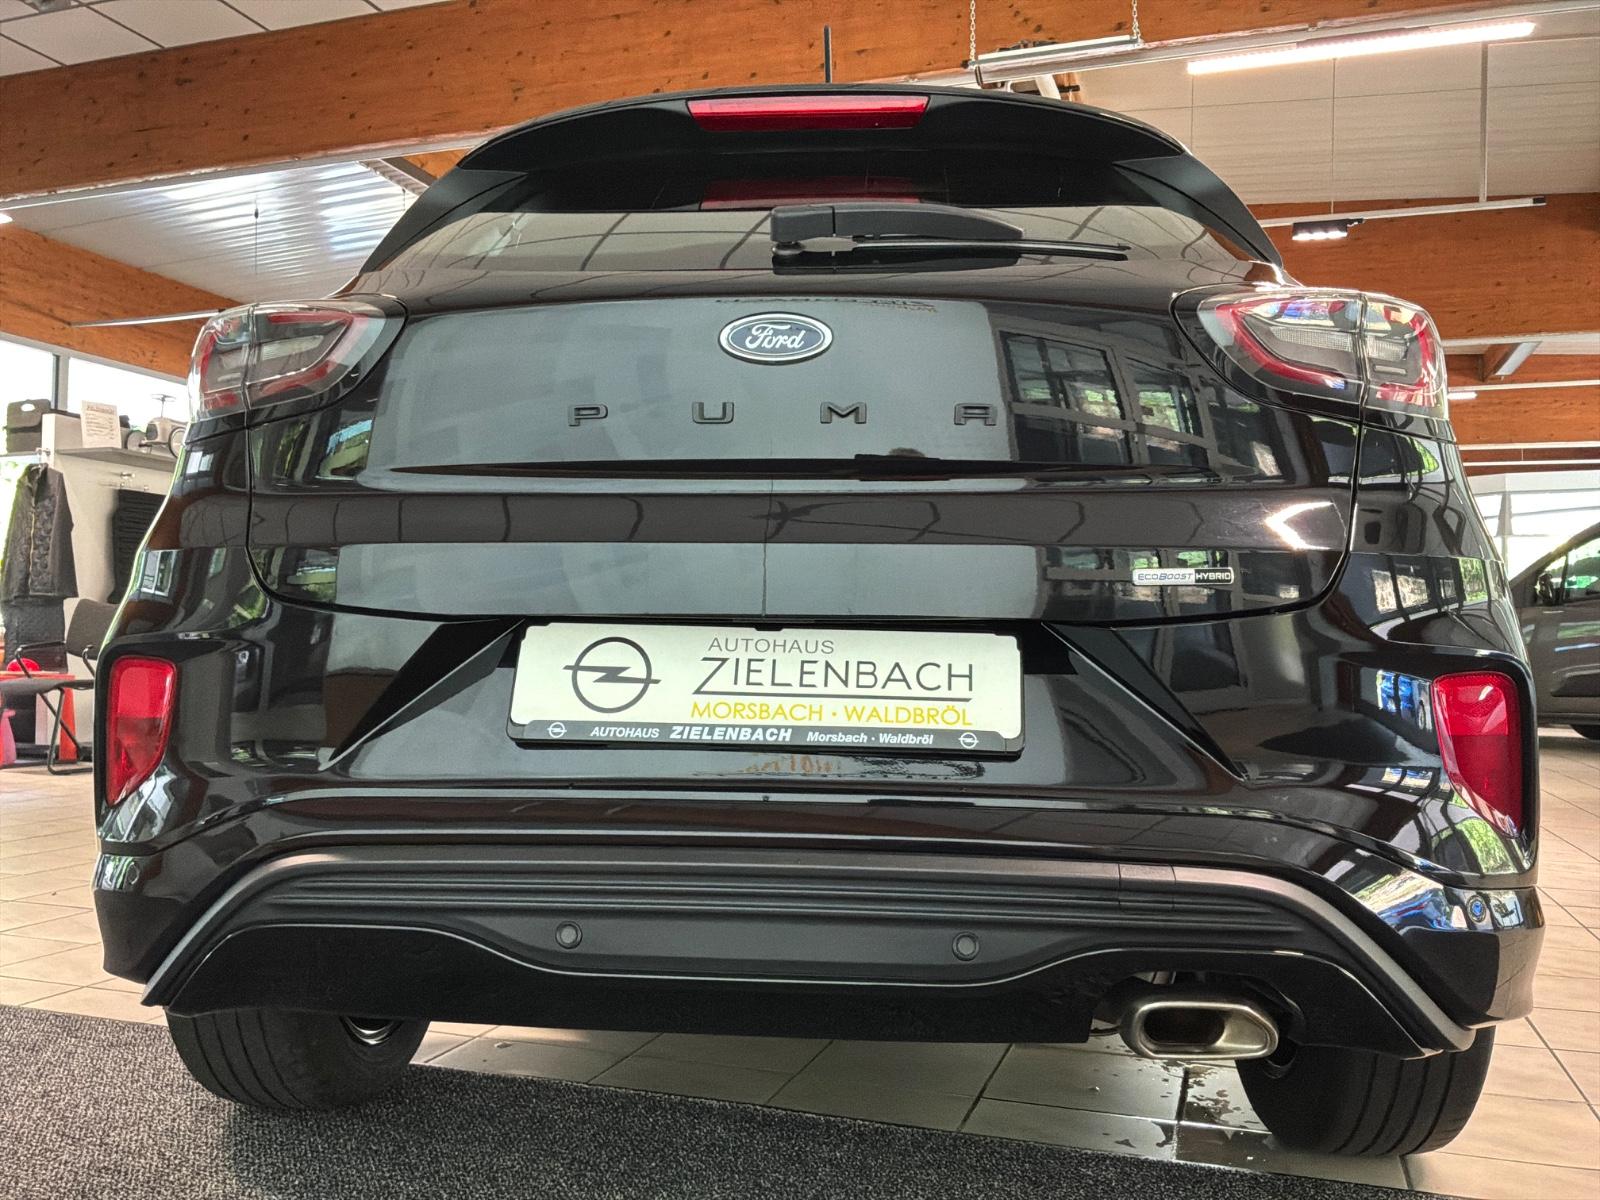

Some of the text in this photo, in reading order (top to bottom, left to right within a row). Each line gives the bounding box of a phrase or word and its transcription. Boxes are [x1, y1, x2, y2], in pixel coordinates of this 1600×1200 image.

[745, 323, 806, 350] Ford
[567, 401, 997, 427] PUMA
[1195, 571, 1231, 581] HYBRID
[708, 637, 834, 655] AUTOHAUS
[692, 657, 973, 694] ZIELENBACH
[691, 701, 973, 726] MORSBACH WALDBRÖL
[590, 725, 933, 744] AUTOHAUS ZIELENBACH Morsbach Waldbröl
